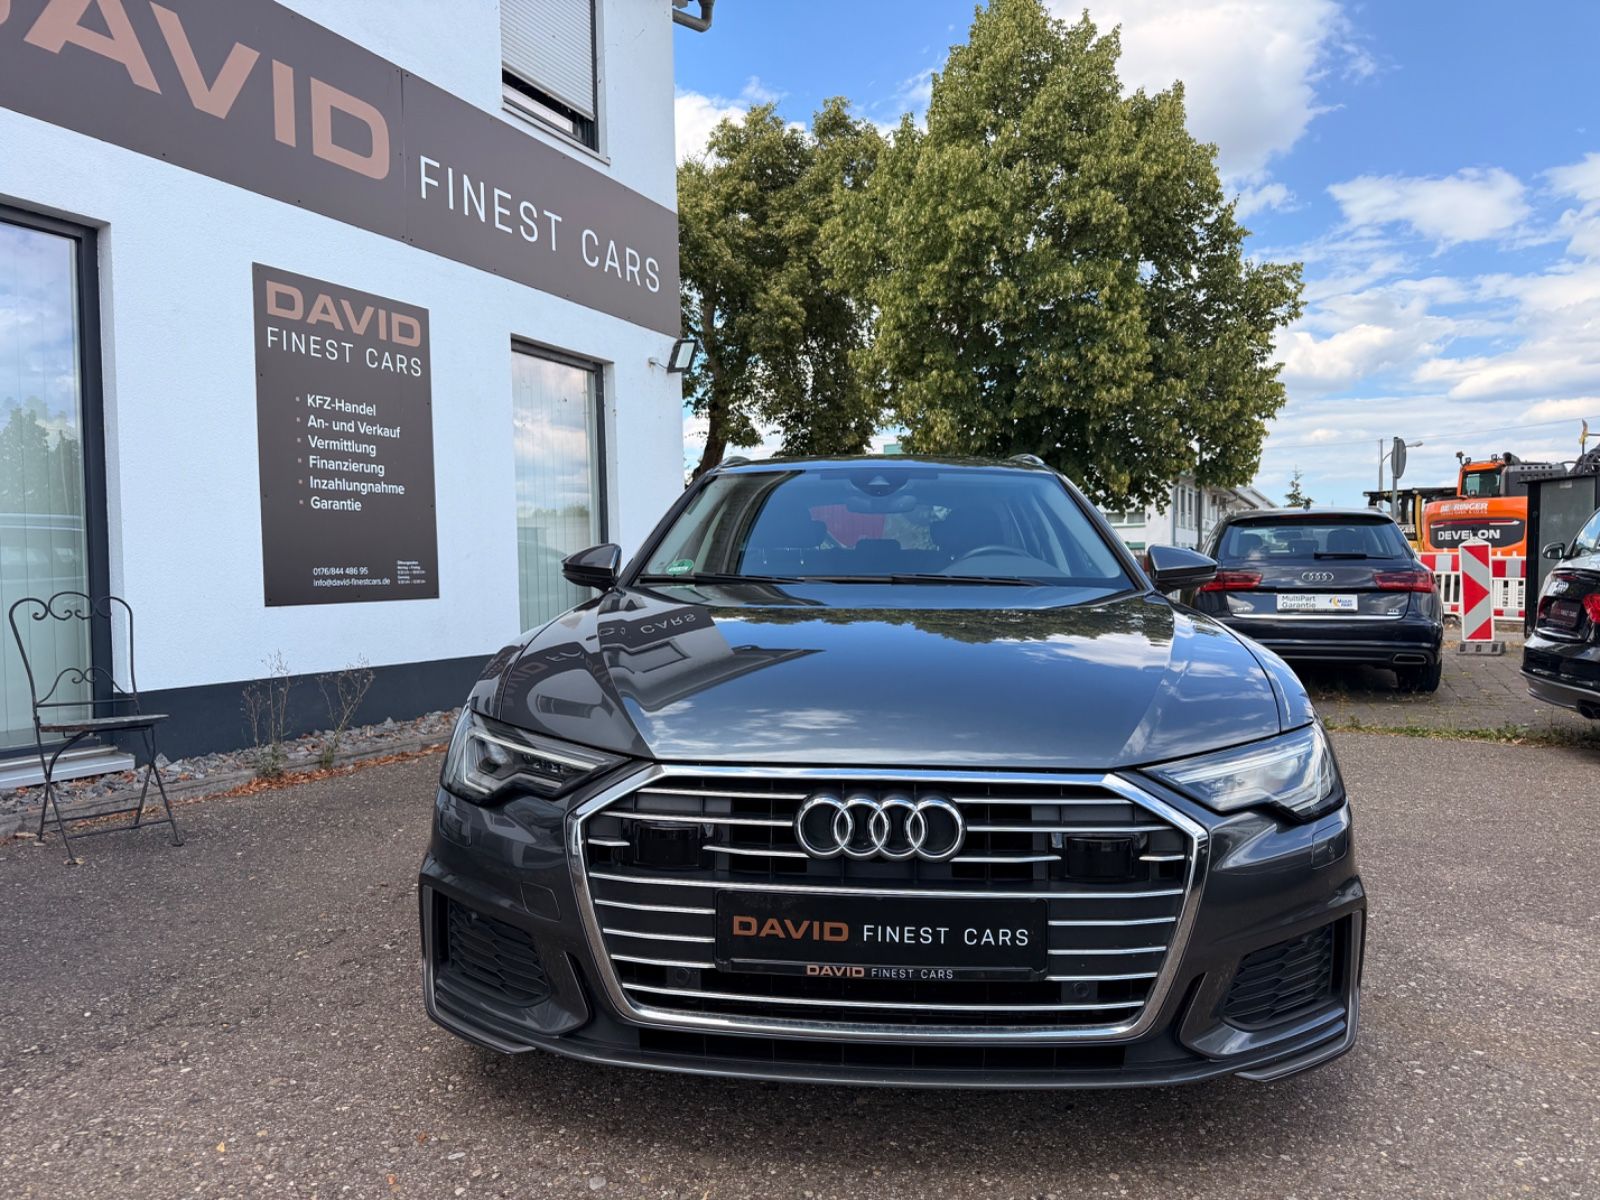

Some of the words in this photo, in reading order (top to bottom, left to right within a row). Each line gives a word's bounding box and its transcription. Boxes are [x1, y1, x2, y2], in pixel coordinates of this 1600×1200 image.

[0, 0, 390, 180] AVID
[420, 155, 562, 251] FINEST
[581, 229, 660, 293] CARS
[266, 280, 421, 347] DAVID
[267, 326, 354, 363] FINEST
[365, 348, 422, 377] CARS
[307, 393, 376, 416] KFZ-Handel
[307, 414, 329, 429] An-
[332, 420, 355, 433] und
[357, 421, 401, 439] Verkauf
[307, 434, 377, 457] Vermittlung
[309, 455, 385, 477] Finanzierung
[309, 475, 405, 495] Inzahlungnahme
[310, 496, 362, 511] Garantie
[733, 915, 849, 942] DAVID
[863, 924, 950, 945] FINEST
[963, 928, 1029, 946] CARS
[806, 964, 865, 978] DAVID
[871, 967, 914, 979] FINEST
[920, 969, 954, 979] CARS
